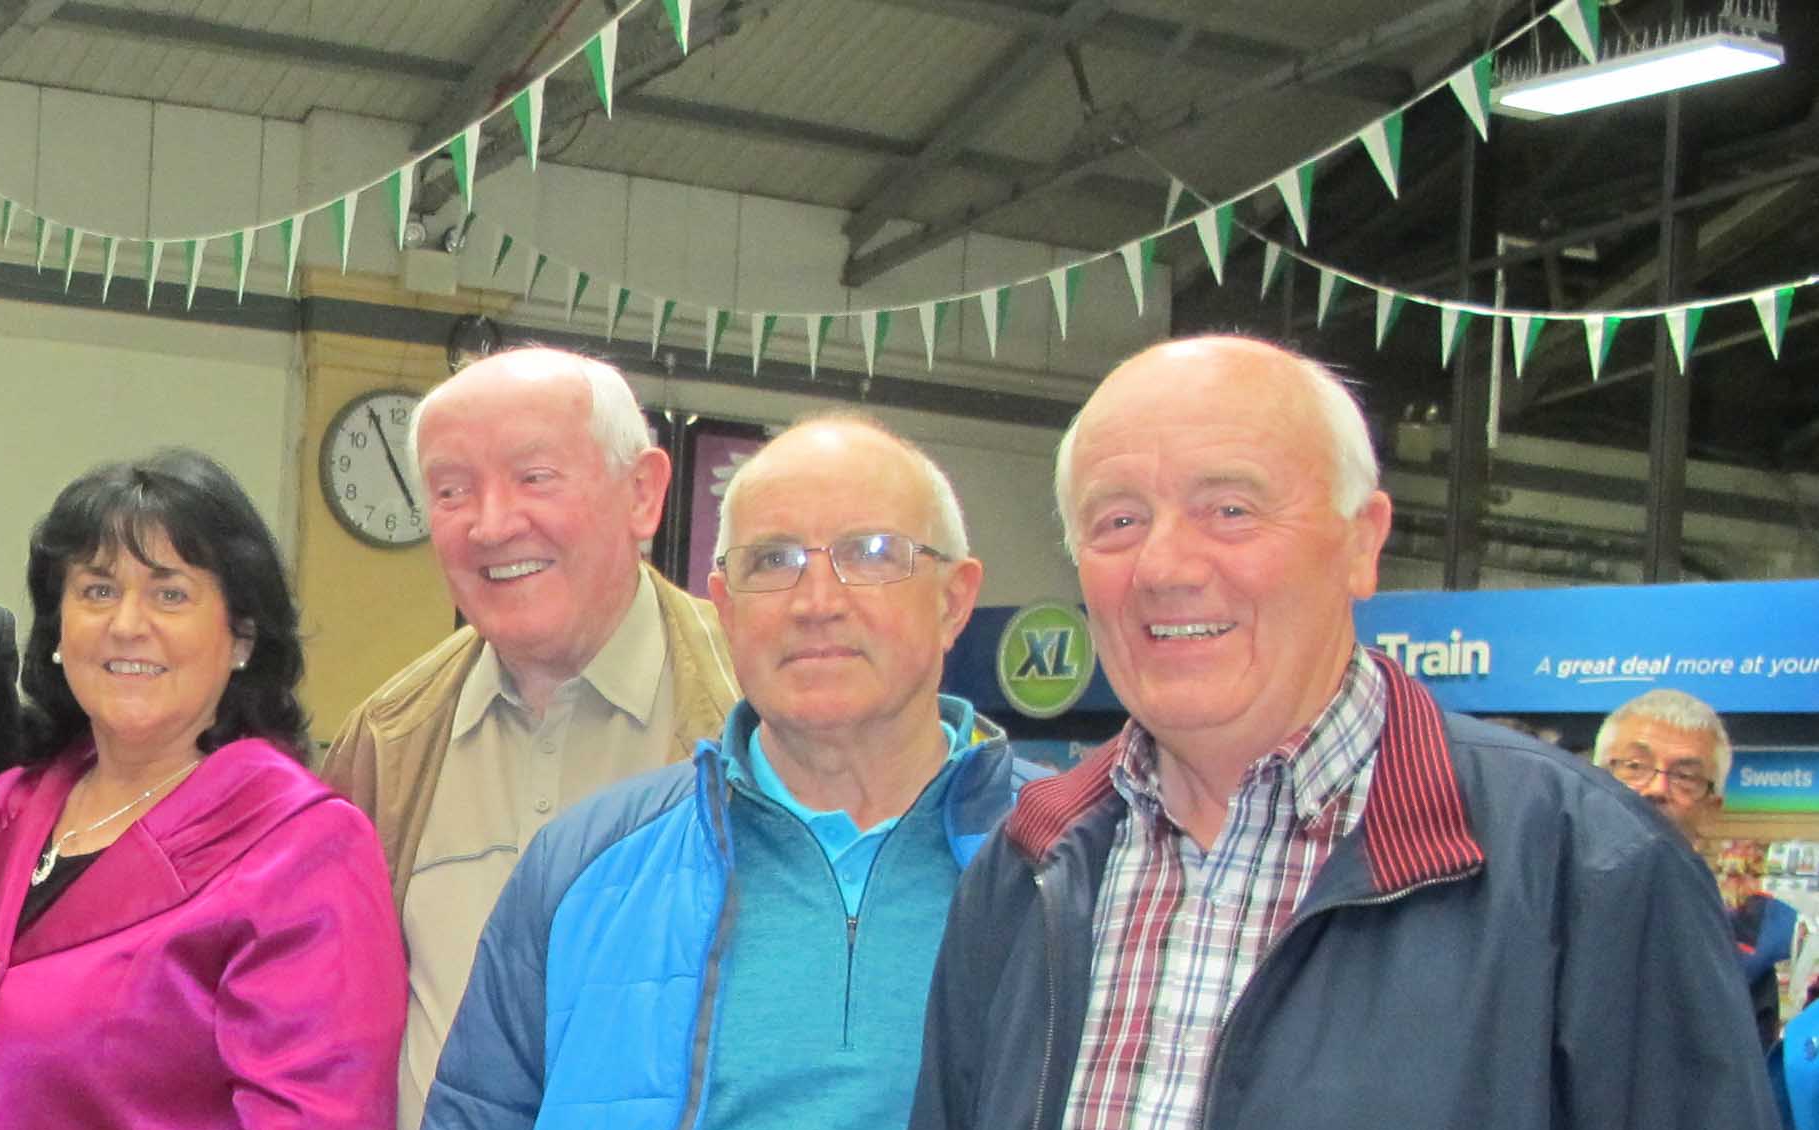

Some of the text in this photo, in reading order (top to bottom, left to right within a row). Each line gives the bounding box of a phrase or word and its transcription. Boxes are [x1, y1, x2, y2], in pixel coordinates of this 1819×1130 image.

[390, 408, 407, 425] 12
[349, 432, 367, 449] 10
[339, 456, 351, 473] 9
[346, 484, 357, 500] 8
[364, 505, 376, 521] 7
[409, 510, 422, 527] 5
[385, 514, 397, 531] 6
[1011, 627, 1078, 680] XL
[1376, 629, 1491, 677] Train
[1534, 656, 1551, 675] A
[1557, 656, 1617, 679] great
[1620, 654, 1670, 675] deal
[1675, 658, 1733, 675] more
[1739, 656, 1764, 675] at
[1740, 767, 1813, 788] Sweets
